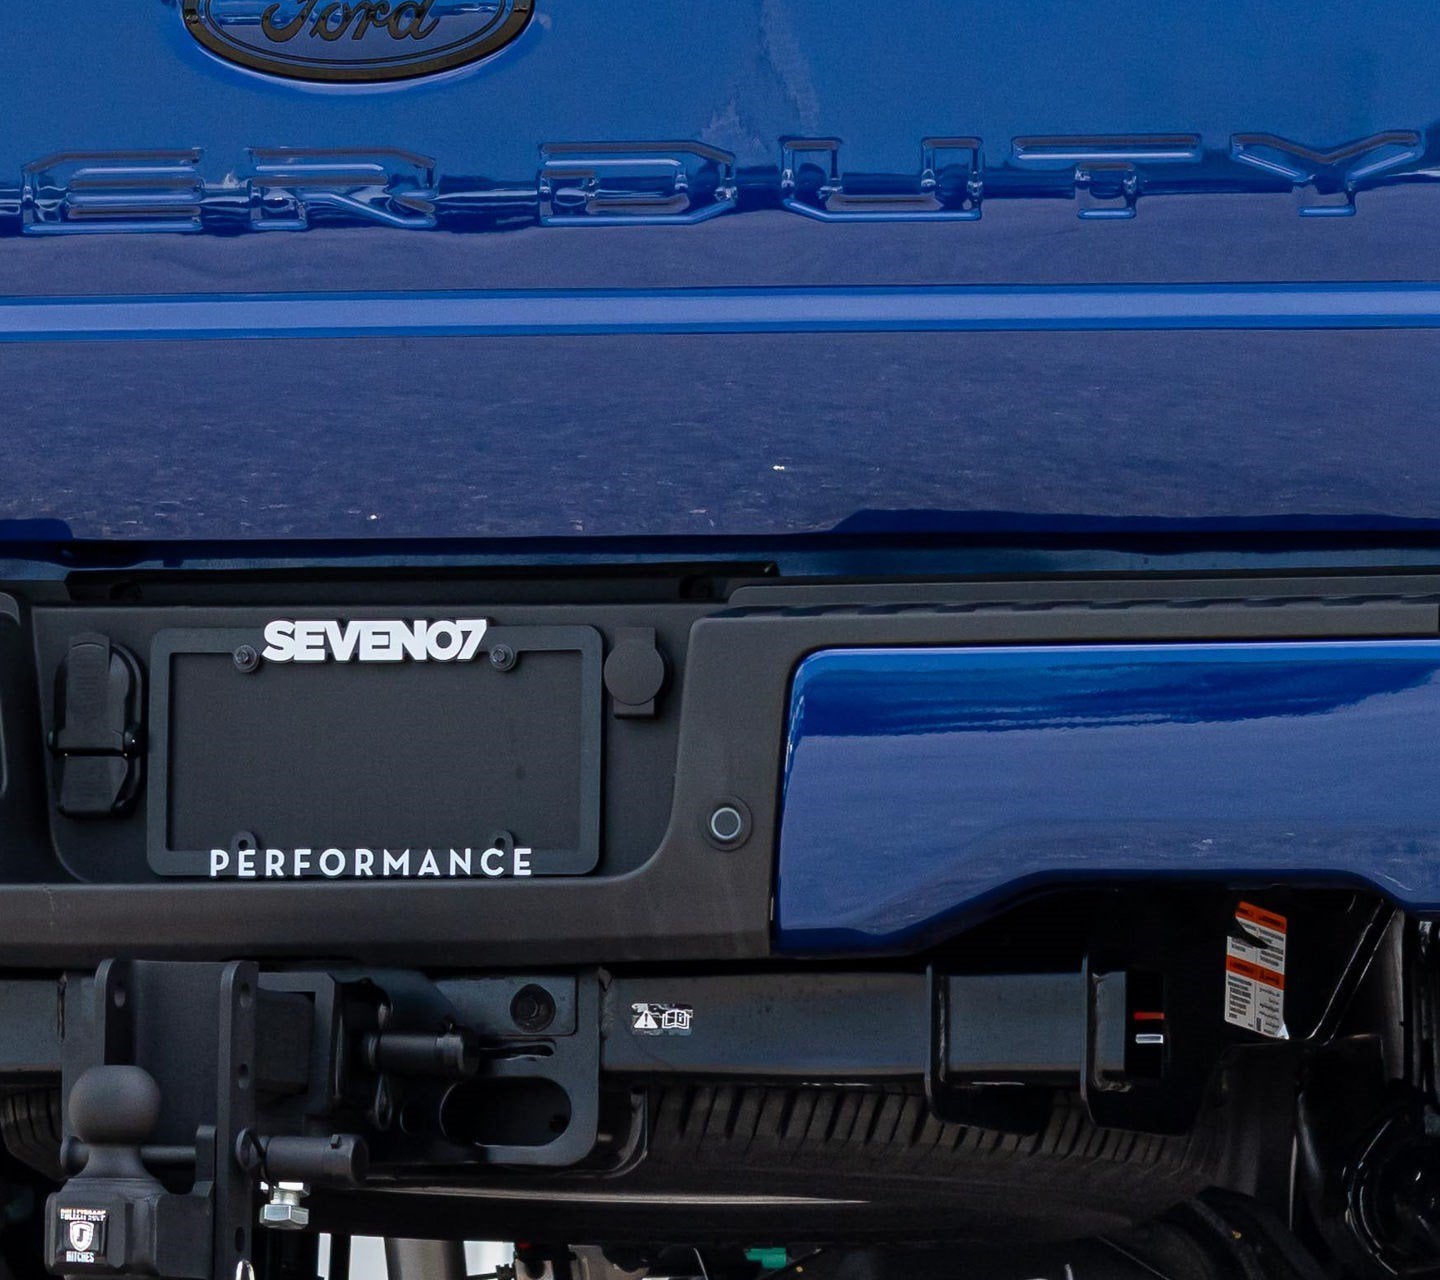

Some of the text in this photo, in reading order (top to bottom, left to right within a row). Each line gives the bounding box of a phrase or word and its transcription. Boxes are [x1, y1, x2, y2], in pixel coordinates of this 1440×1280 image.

[537, 131, 1424, 226] DUTY
[211, 848, 534, 877] PERFORMANCE
[65, 1250, 95, 1263] HITCHES
